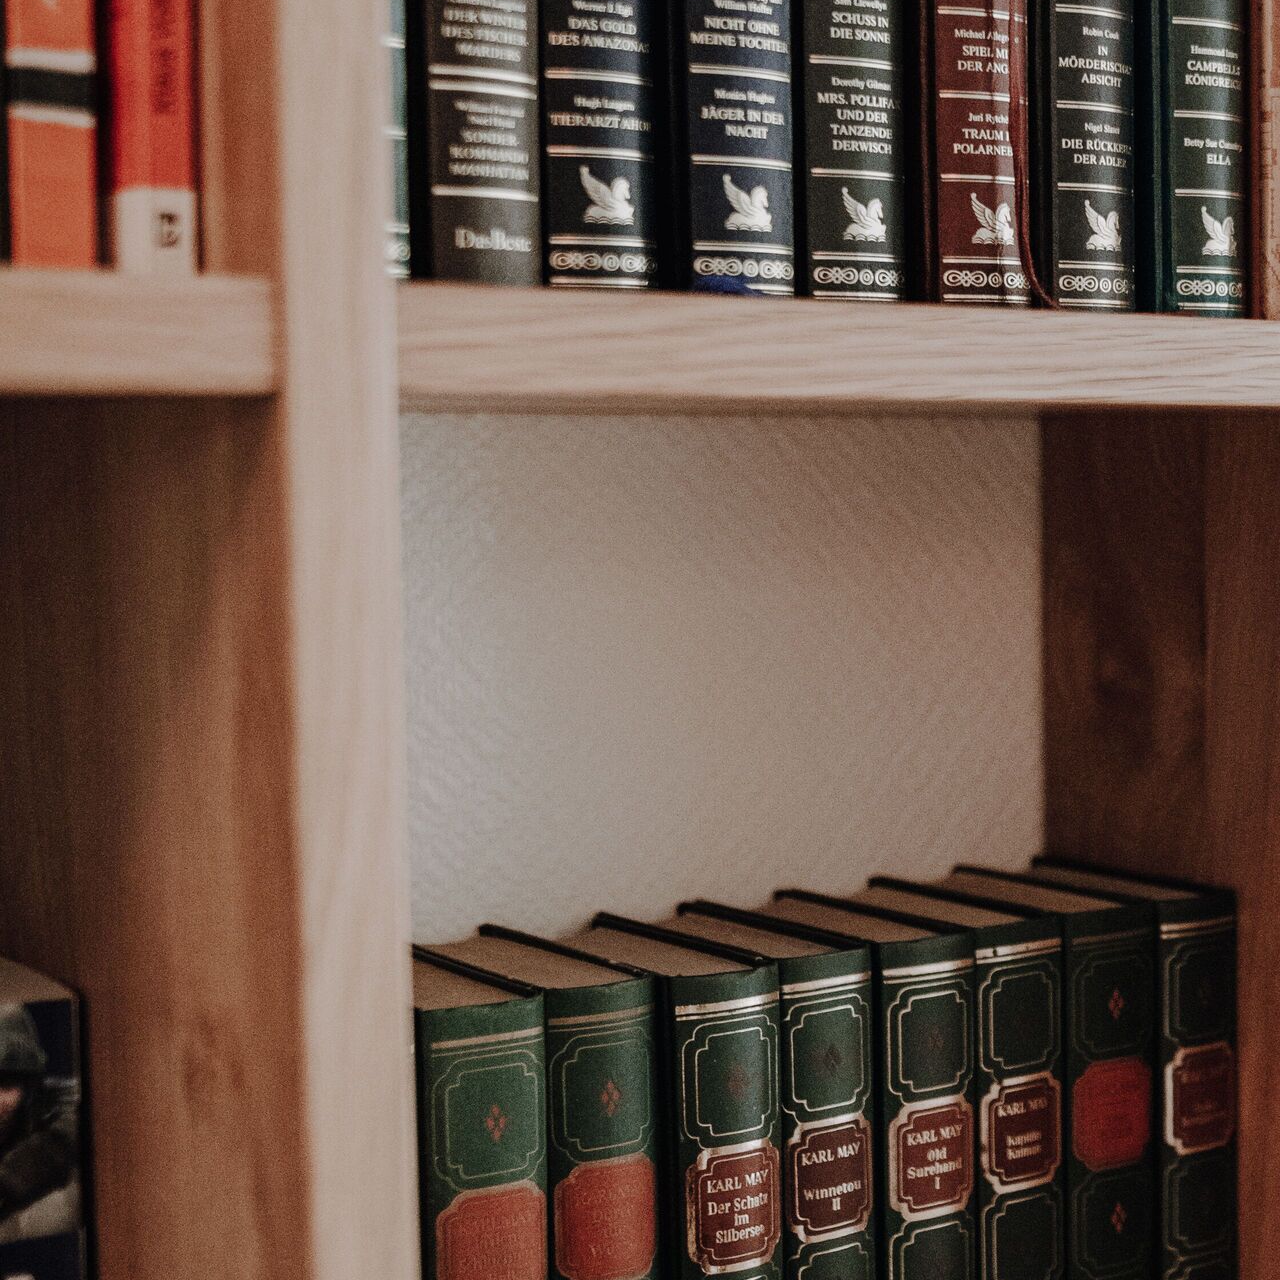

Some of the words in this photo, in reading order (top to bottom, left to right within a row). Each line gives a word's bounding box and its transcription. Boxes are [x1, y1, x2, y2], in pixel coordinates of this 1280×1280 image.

[568, 17, 598, 32] DAS
[600, 18, 637, 36] GOLD
[704, 17, 747, 32] NICHT
[748, 19, 781, 36] OHNE
[831, 11, 877, 28] SCHUSS
[878, 15, 890, 29] IN
[548, 30, 580, 46] DES
[830, 26, 853, 40] DIE
[855, 28, 891, 44] SONNE
[1082, 26, 1103, 38] Robin
[690, 32, 737, 47] MEINE
[738, 34, 789, 53] TOCHTER
[1098, 45, 1109, 56] IN
[957, 60, 983, 72] DER
[1081, 73, 1122, 88] ABSICHT
[817, 92, 849, 106] MRS.
[700, 105, 745, 122] JÄGER
[747, 108, 761, 123] IN
[762, 110, 785, 125] DER
[836, 108, 864, 121] UND
[866, 110, 889, 124] DER
[725, 124, 768, 140] NACHT
[830, 123, 893, 139] TANZENDE
[962, 128, 1004, 142] TRAUM
[832, 139, 893, 155] DERWISCH
[1061, 138, 1083, 150] DIE
[1074, 154, 1098, 166] DER
[1099, 155, 1127, 168] ADLER
[1206, 153, 1231, 166] ELLA
[454, 227, 491, 250] Das
[998, 1100, 1026, 1118] KARL
[907, 1128, 937, 1147] KARL
[939, 1123, 962, 1141] MAY
[801, 1148, 835, 1168] KARL
[837, 1141, 860, 1160] MAY
[926, 1147, 947, 1163] Old
[907, 1158, 962, 1180] Surehand
[706, 1173, 742, 1195] KARL
[744, 1168, 769, 1187] MAY
[803, 1179, 862, 1202] Winnetou
[708, 1199, 732, 1216] Der
[734, 1192, 769, 1213] Schatz
[832, 1198, 841, 1211] II
[735, 1212, 749, 1226] im
[715, 1223, 765, 1244] Silbersee
